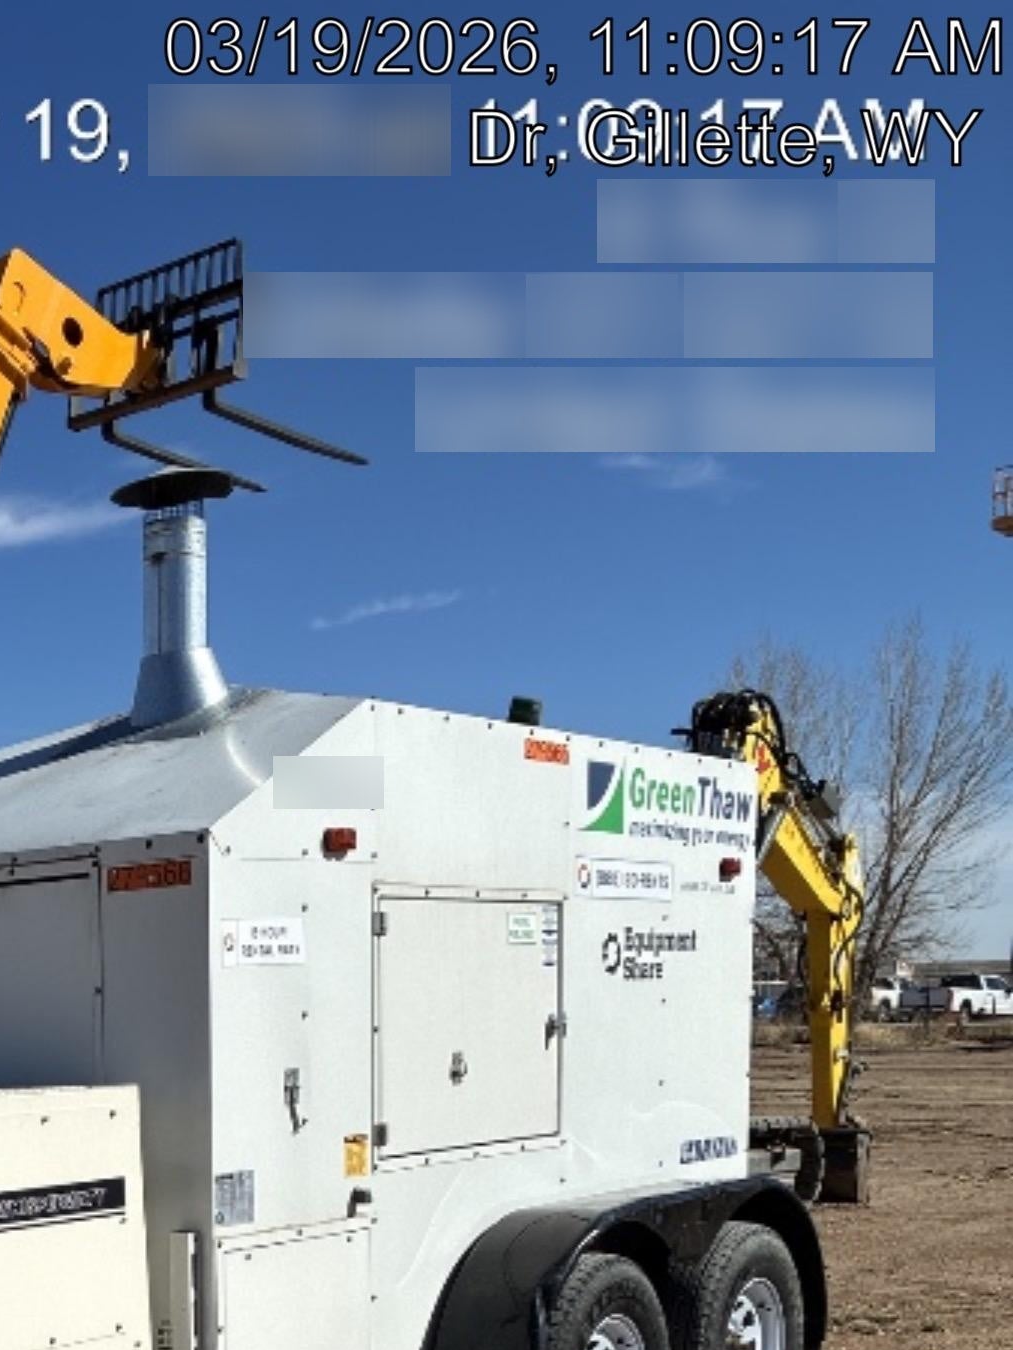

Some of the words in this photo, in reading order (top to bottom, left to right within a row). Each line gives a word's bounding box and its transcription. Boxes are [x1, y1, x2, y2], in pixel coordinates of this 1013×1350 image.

[629, 767, 753, 823] GreenThaw
[623, 926, 697, 957] Equipment
[623, 956, 663, 980] Share
